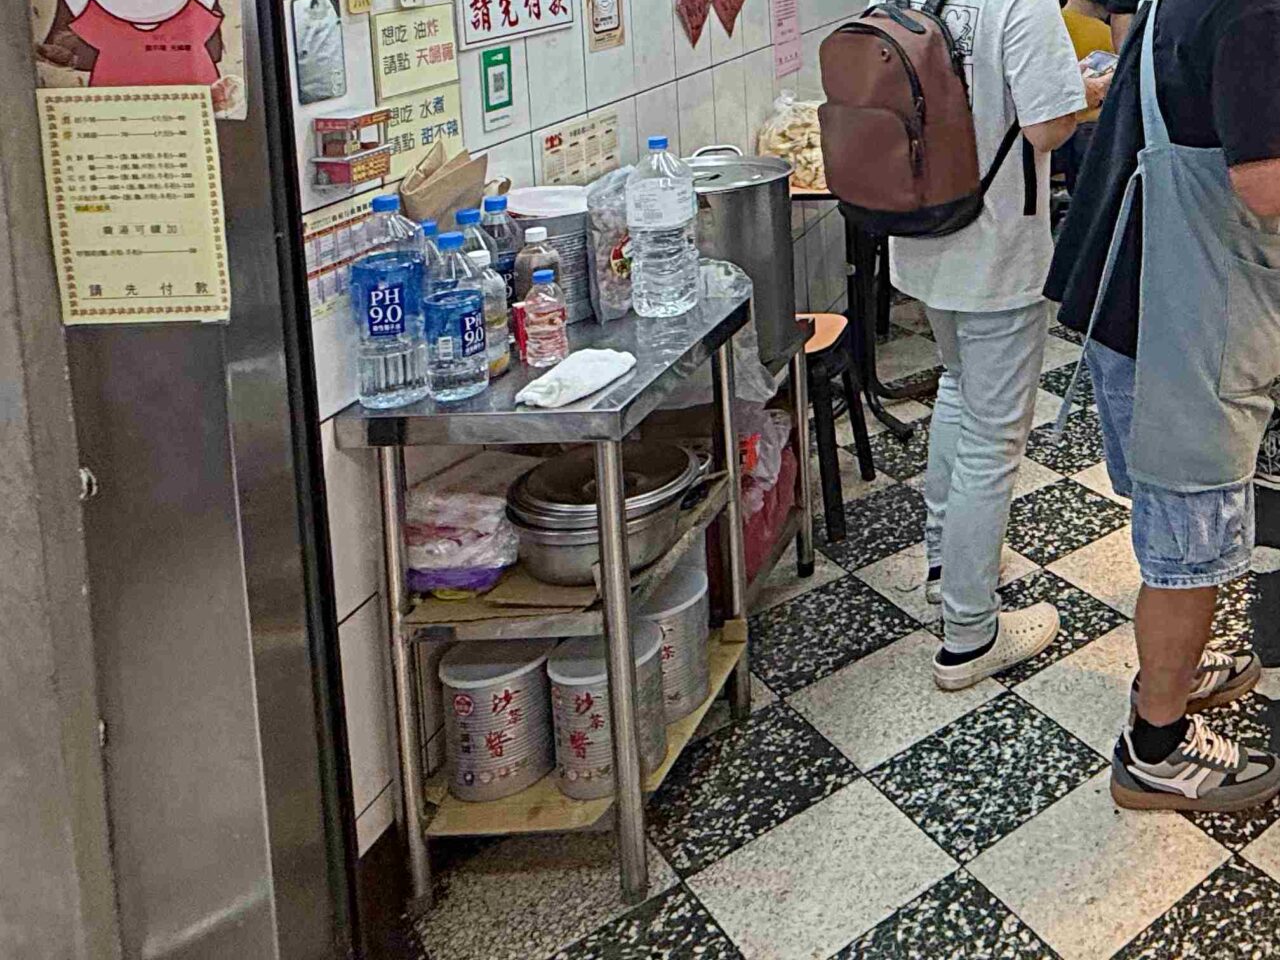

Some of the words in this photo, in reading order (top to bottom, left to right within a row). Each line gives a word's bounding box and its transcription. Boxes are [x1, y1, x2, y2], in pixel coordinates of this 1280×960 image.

[382, 24, 407, 46] 想吃
[414, 19, 439, 40] 油炸
[383, 52, 411, 75] 請點
[389, 105, 413, 127] 想吃
[420, 95, 444, 119] 水煮
[421, 119, 458, 145] 甜不辣
[89, 282, 209, 297] 請先付款
[371, 288, 400, 306] PH
[370, 305, 402, 324] 9.0
[464, 312, 482, 332] PH
